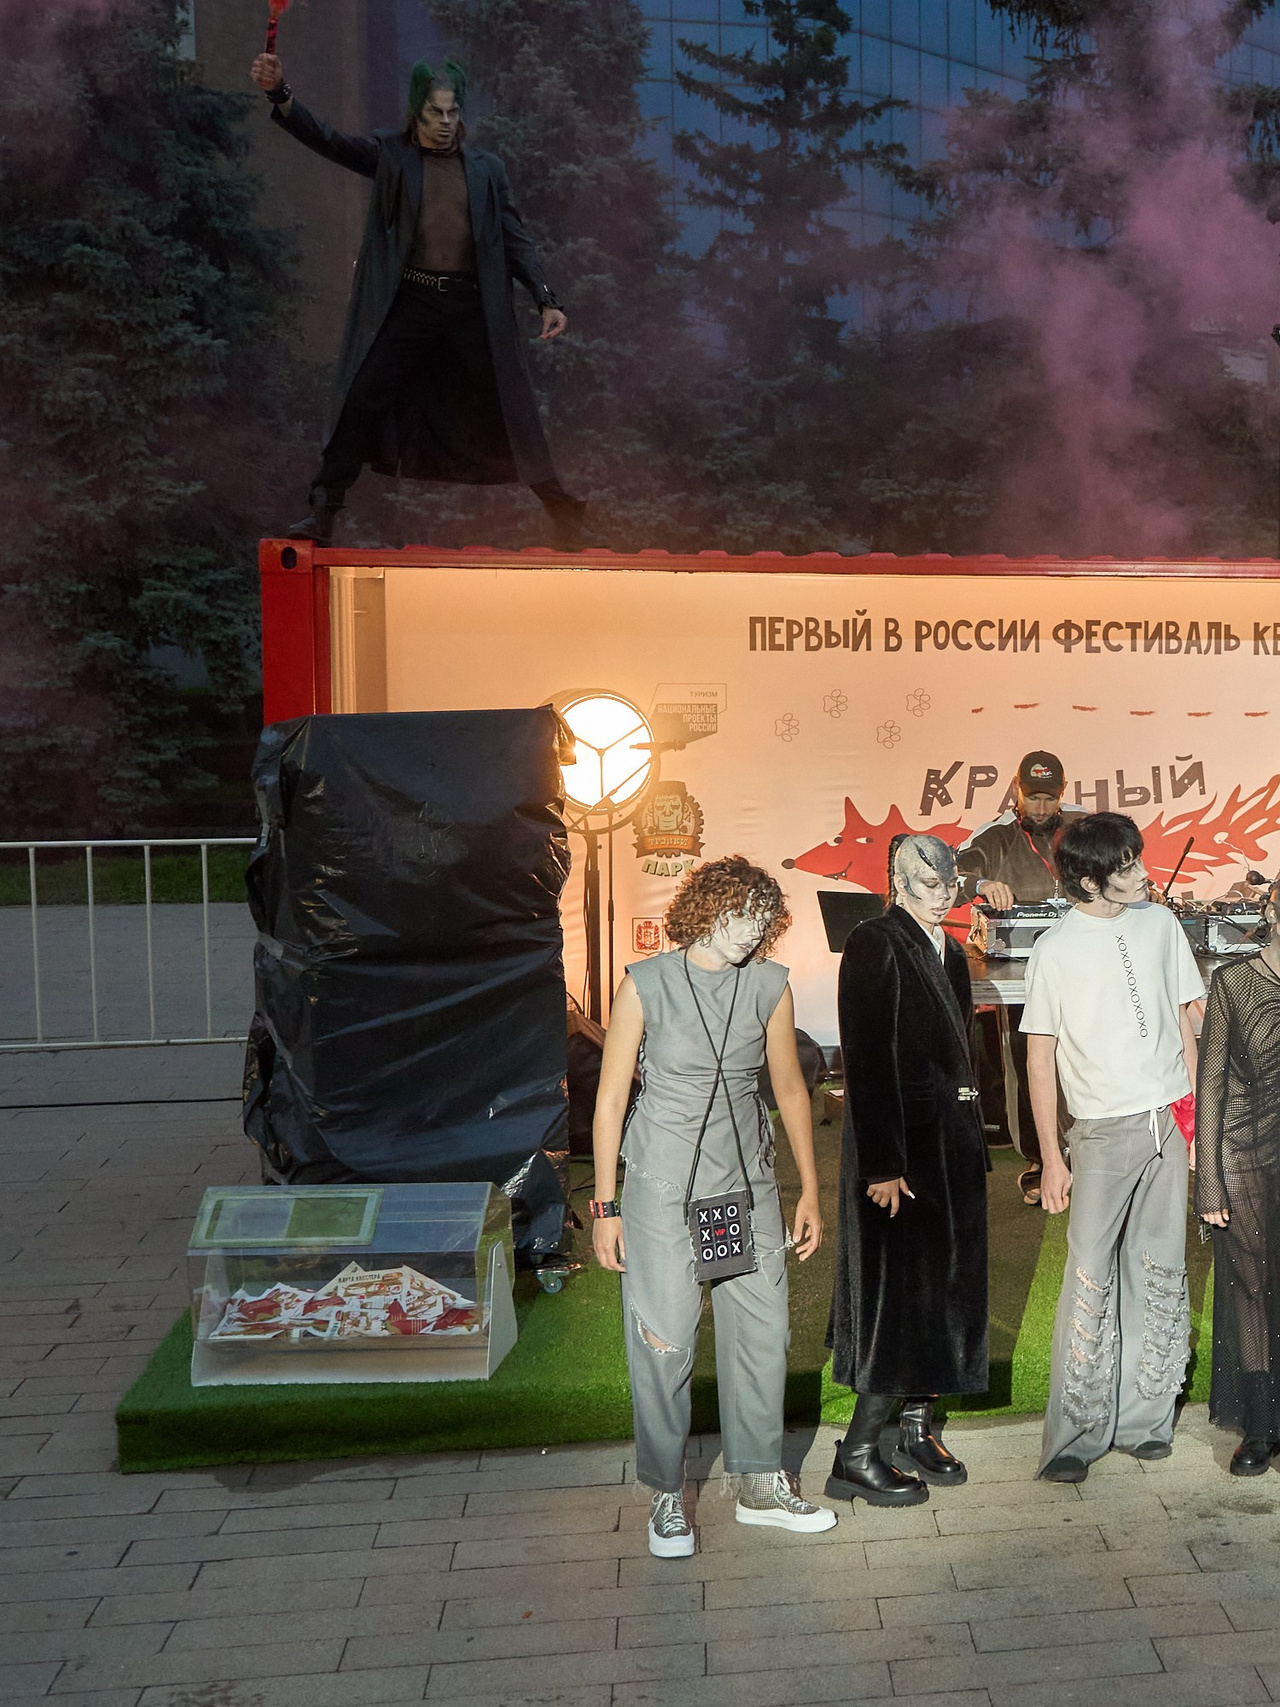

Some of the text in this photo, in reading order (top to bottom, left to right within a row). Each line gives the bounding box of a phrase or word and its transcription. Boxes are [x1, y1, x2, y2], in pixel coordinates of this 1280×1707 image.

[749, 608, 872, 652] ПЕРВЫЙ
[884, 617, 902, 652] В
[915, 618, 1040, 653] РОССИИ
[1052, 619, 1241, 655] ФЕСТИВАЛЬ
[657, 704, 717, 714] НАЦИОНАЛЬНЫЕ
[682, 713, 717, 723] ПРОЕКТЫ
[689, 723, 717, 732] РОССИИ
[918, 754, 1206, 816] КРНЫЙ
[641, 859, 697, 877] ПАРК
[714, 1228, 726, 1236] VIP
